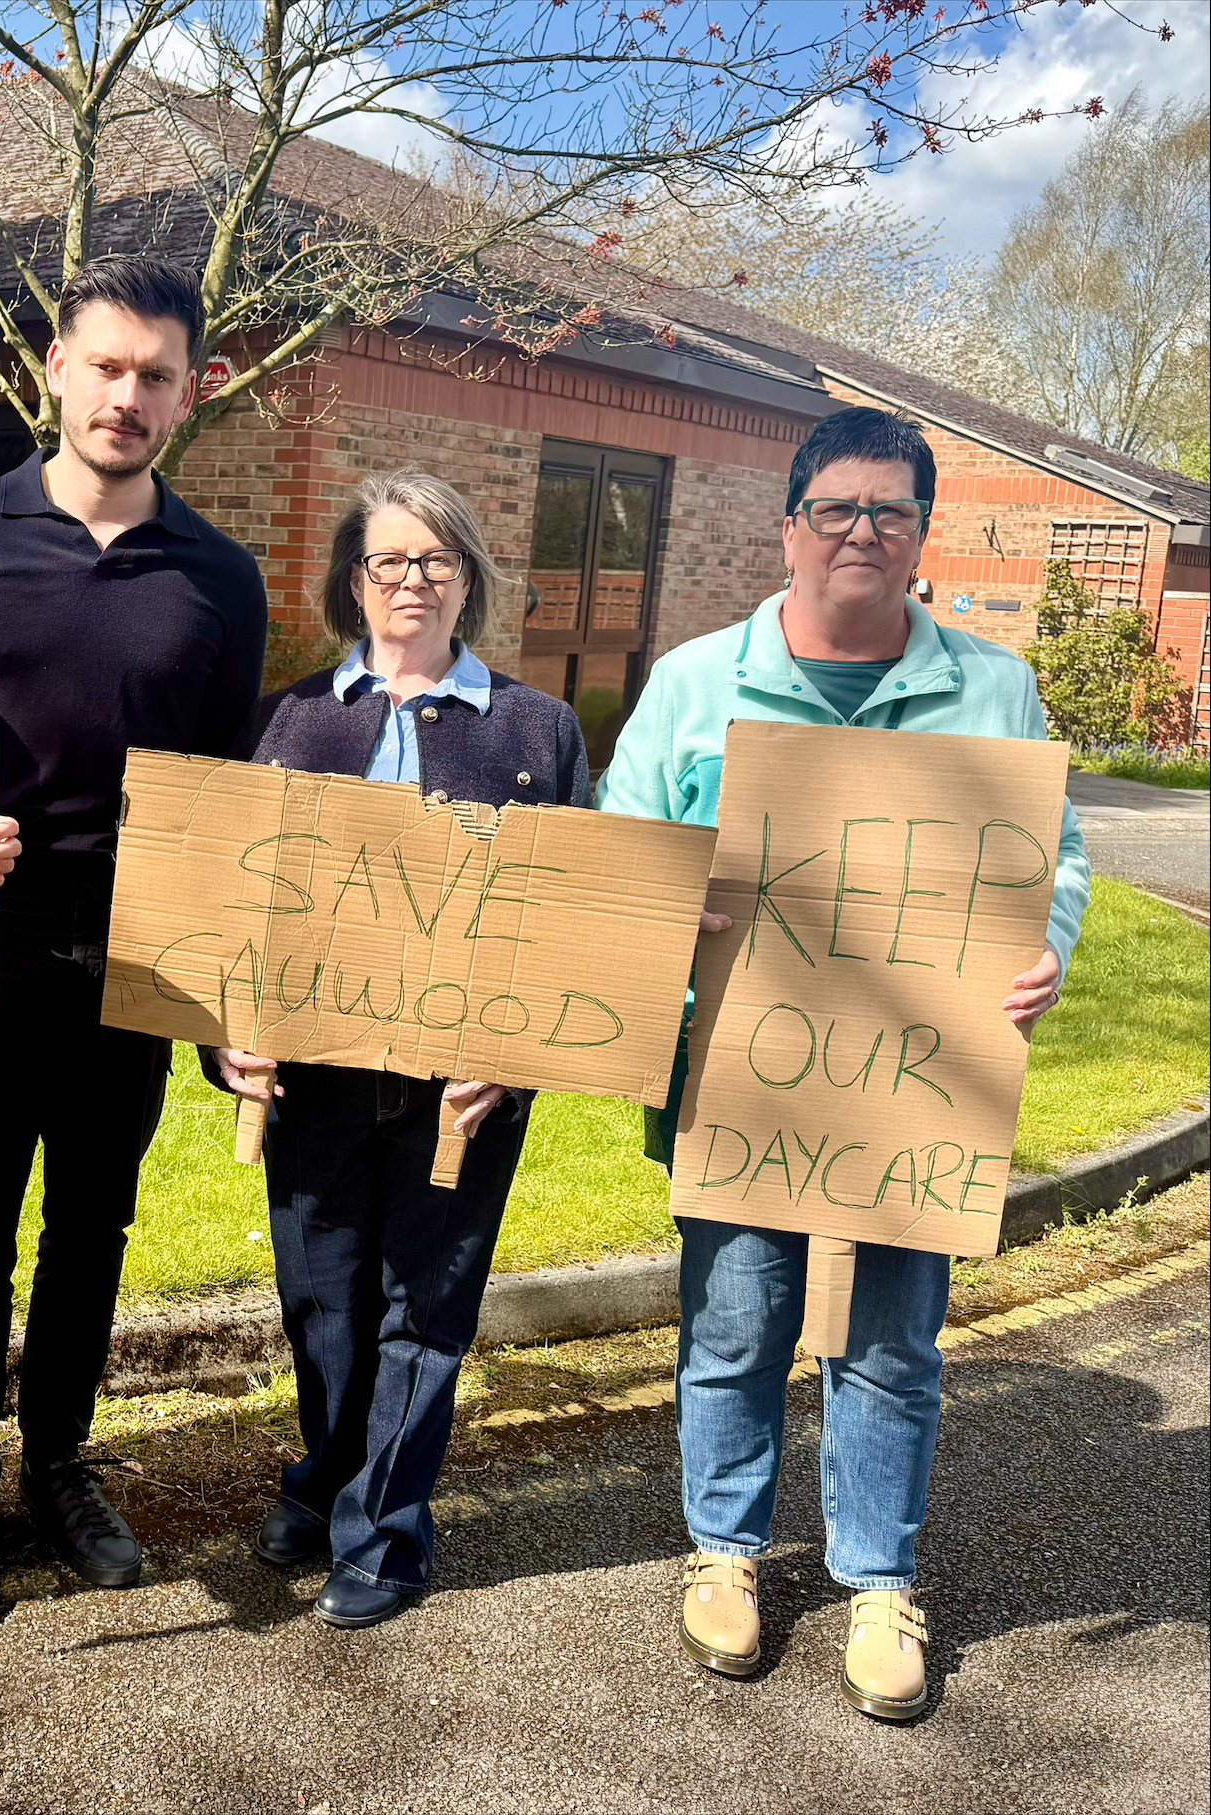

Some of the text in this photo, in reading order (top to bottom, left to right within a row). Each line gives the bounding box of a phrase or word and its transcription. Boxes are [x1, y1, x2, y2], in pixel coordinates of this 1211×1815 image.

[223, 832, 568, 943] SAVE
[745, 811, 1050, 979] KEEP
[152, 932, 625, 1048] CAUWOOD
[748, 1002, 954, 1108] OUR
[695, 1123, 1011, 1217] DAYCARE
